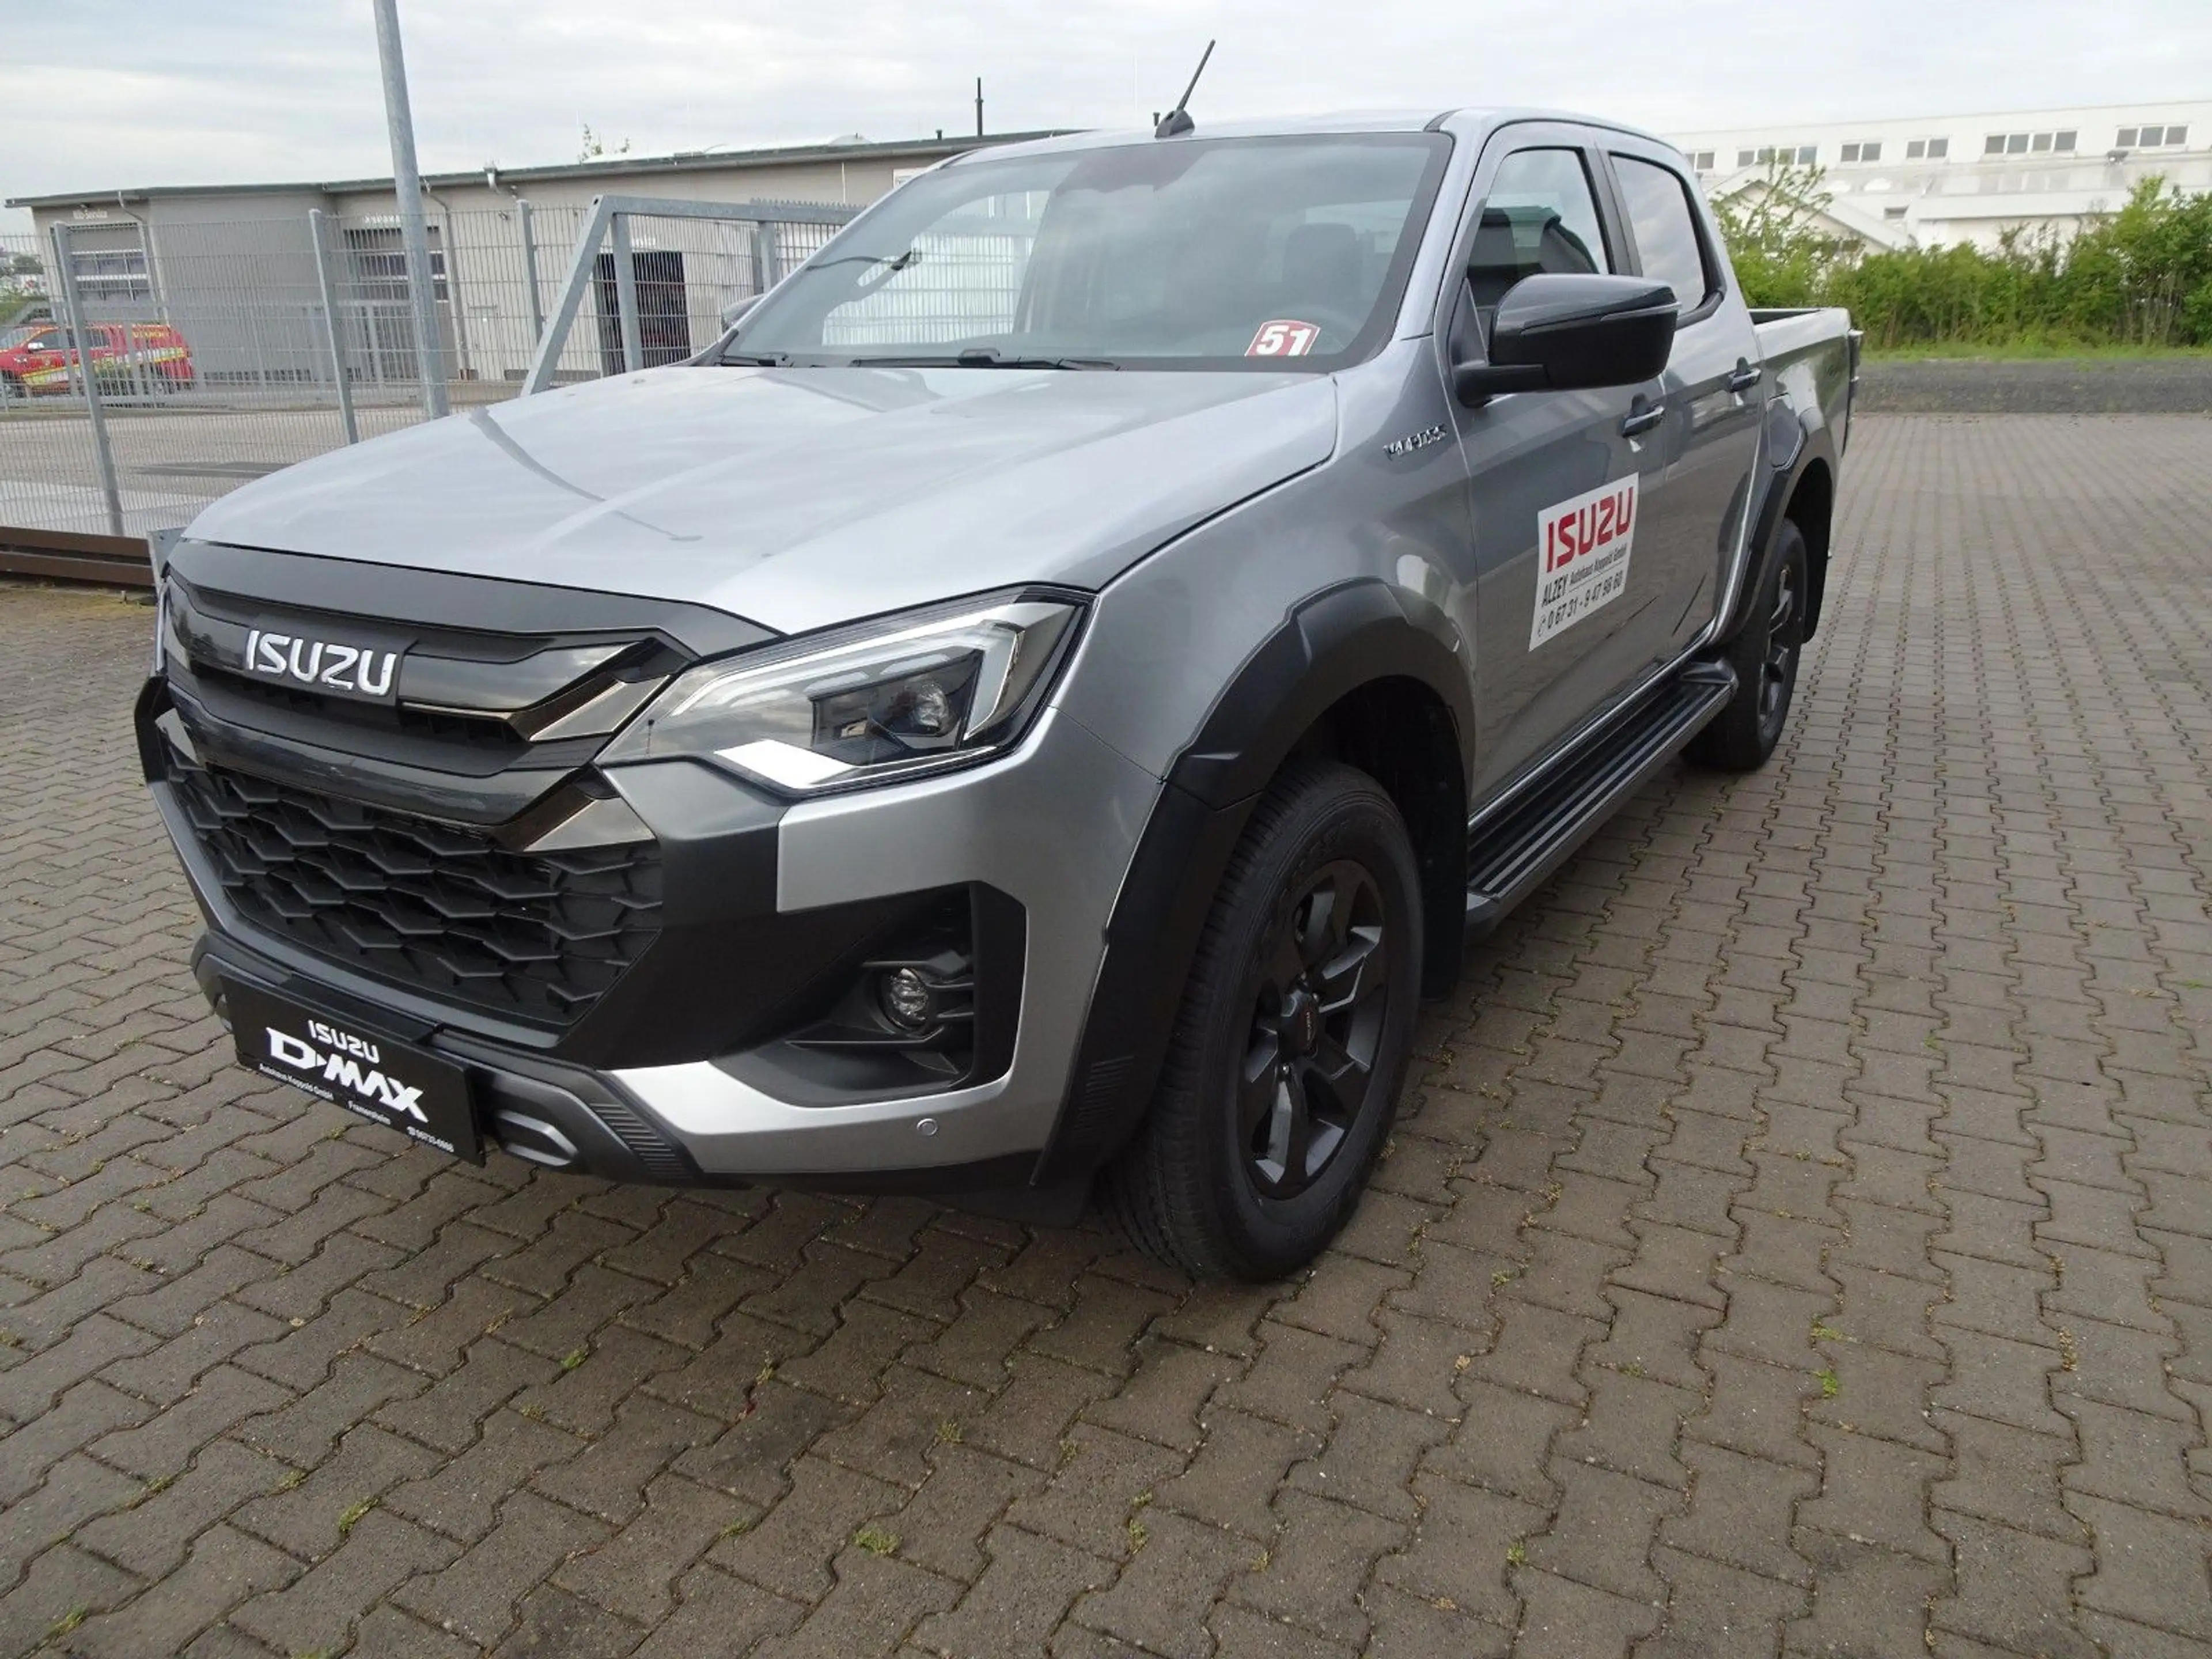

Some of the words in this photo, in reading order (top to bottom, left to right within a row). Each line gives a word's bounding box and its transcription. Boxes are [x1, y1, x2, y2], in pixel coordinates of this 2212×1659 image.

[1256, 325, 1312, 357] 51
[1546, 487, 1633, 573] ISUZU
[1541, 574, 1569, 607] ALZEY
[245, 630, 397, 696] ISUZU
[308, 1019, 380, 1065] ISUZU
[266, 1027, 429, 1123] D-MAX
